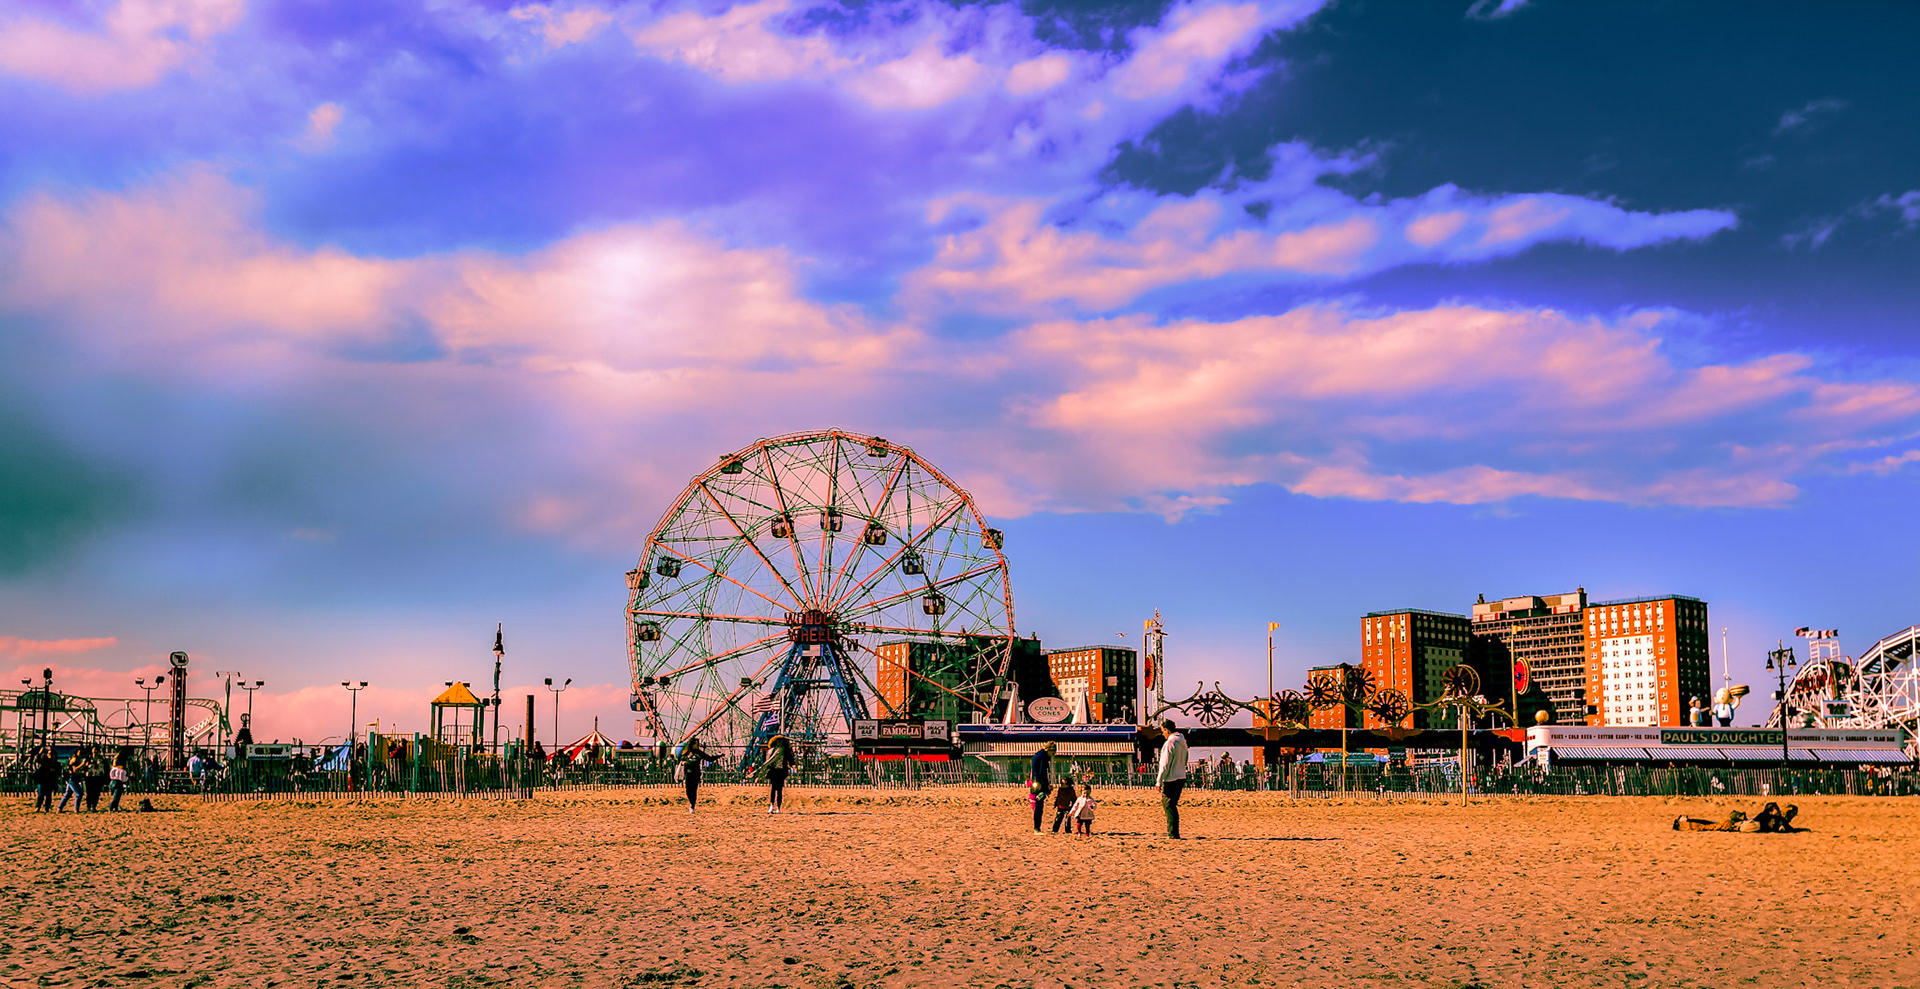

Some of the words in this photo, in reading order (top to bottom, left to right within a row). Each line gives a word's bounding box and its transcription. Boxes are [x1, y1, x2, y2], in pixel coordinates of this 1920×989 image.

[784, 611, 839, 625] WONDER
[788, 628, 836, 642] WHEEL
[882, 727, 920, 735] FAMIGLIA
[1663, 732, 1708, 744] PAUL'S
[1711, 733, 1784, 744] DAUGHTER
